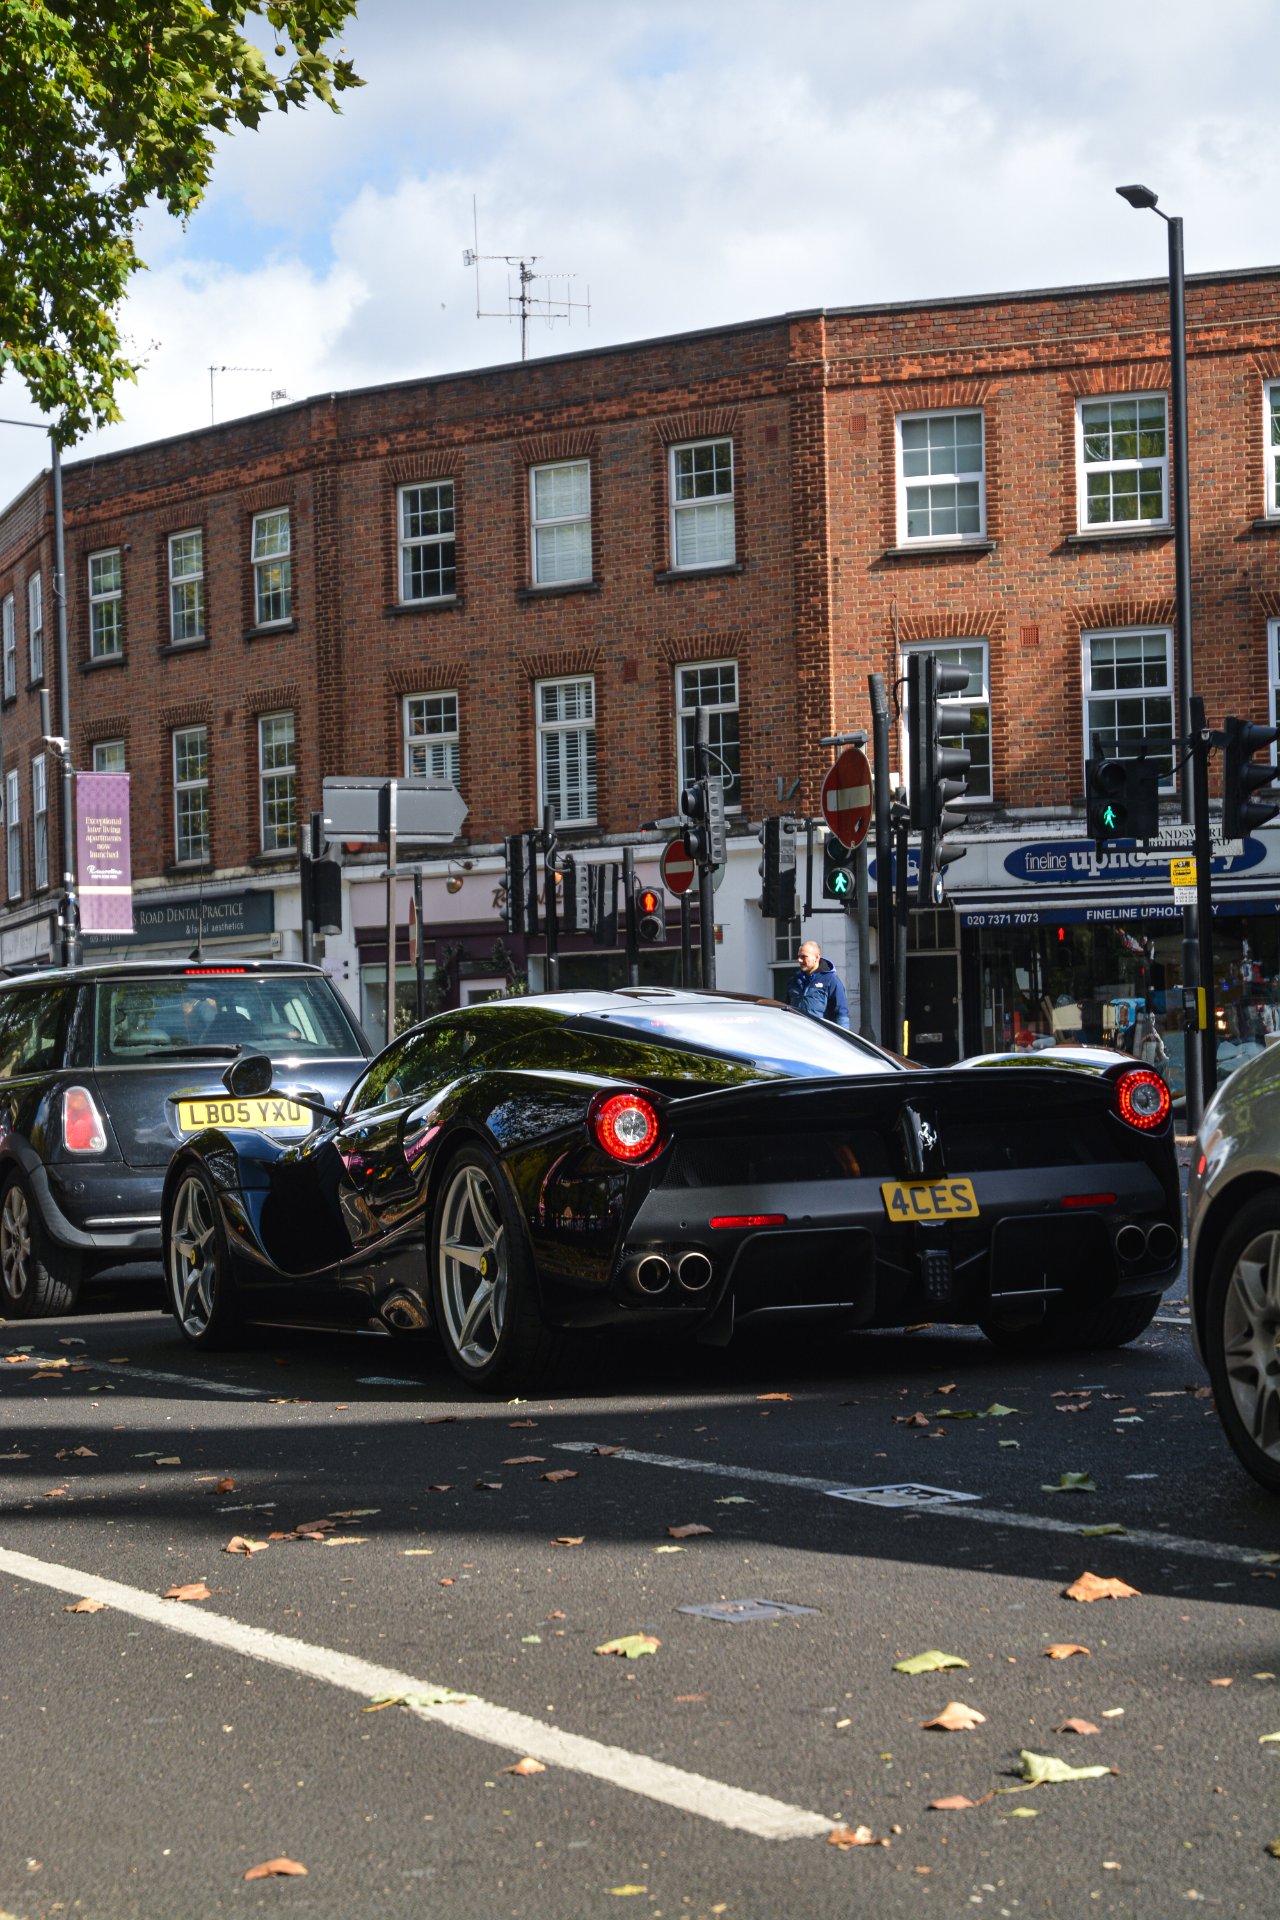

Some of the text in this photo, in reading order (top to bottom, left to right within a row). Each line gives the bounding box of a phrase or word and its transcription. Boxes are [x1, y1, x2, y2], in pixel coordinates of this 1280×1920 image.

[85, 816, 122, 826] Exceptional
[87, 825, 121, 833] later living
[85, 835, 122, 843] apartments
[89, 850, 119, 859] launched
[1025, 851, 1067, 871] fineline
[140, 911, 164, 925] ROAD
[167, 907, 200, 922] DENTAL
[202, 903, 244, 919] PRACTICE
[967, 912, 1039, 926] 020 7371 7073
[1086, 908, 1138, 920] FINELINE
[191, 923, 209, 934] faal
[211, 922, 244, 933] aesthetics
[189, 1102, 251, 1125] LB05
[891, 1184, 973, 1216] 4CES
